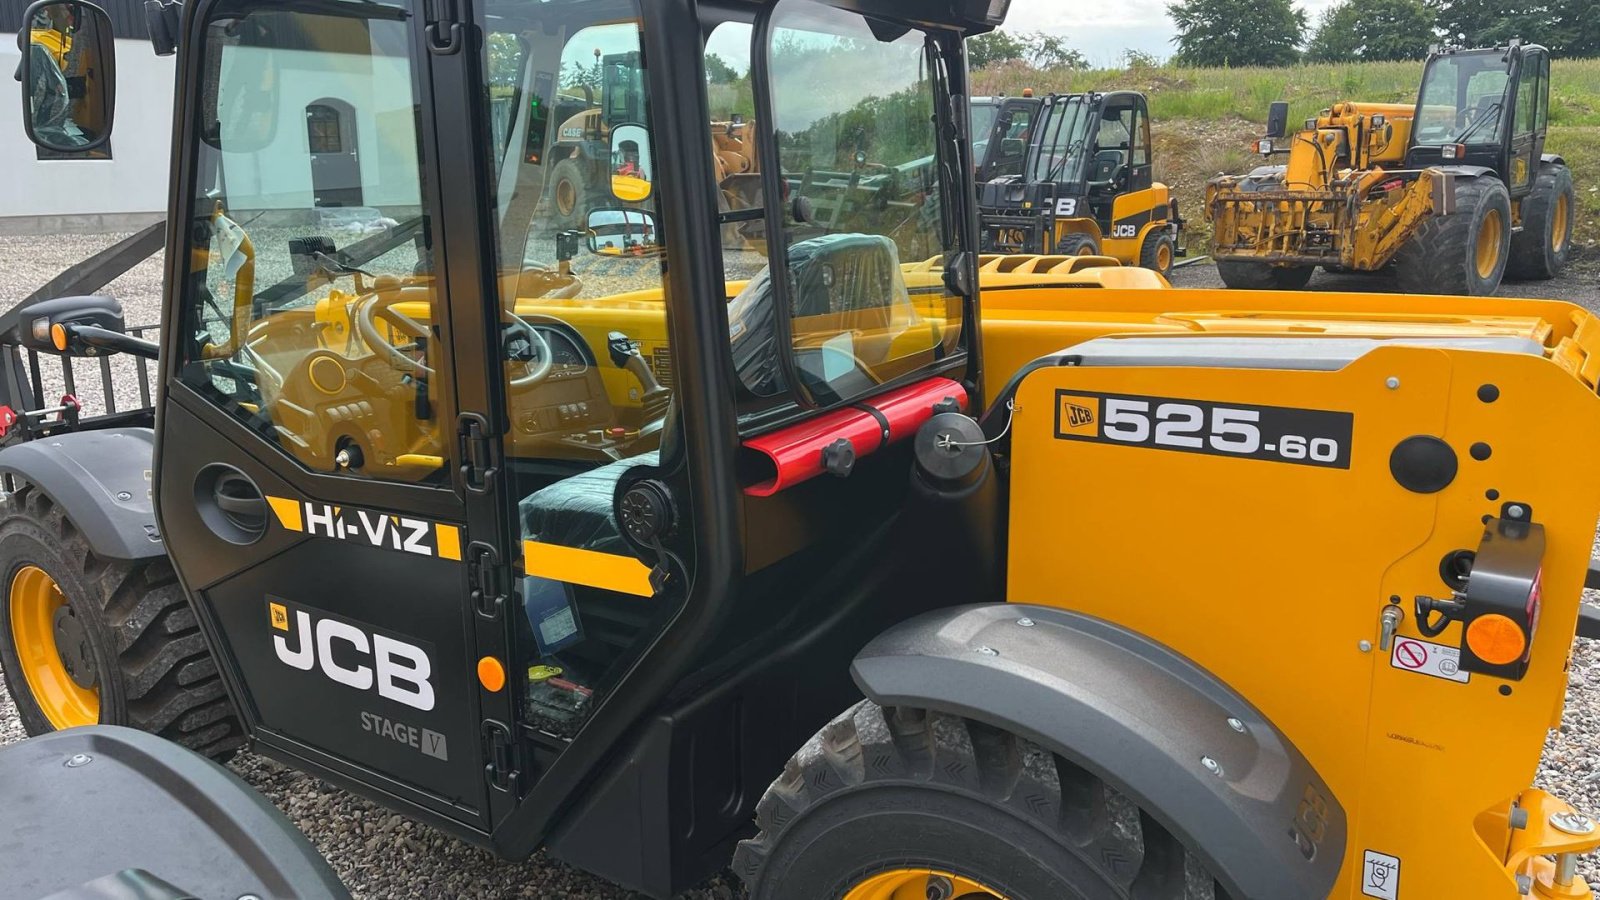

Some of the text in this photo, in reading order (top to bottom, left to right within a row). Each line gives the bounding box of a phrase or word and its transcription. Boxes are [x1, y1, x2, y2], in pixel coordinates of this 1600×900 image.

[562, 127, 582, 138] CASE
[1113, 224, 1136, 237] JCB
[1068, 404, 1094, 424] JCB
[1103, 398, 1339, 463] 525-60
[273, 610, 435, 712] JCB
[361, 711, 441, 753] STAGE V
[1287, 783, 1328, 863] JCB
